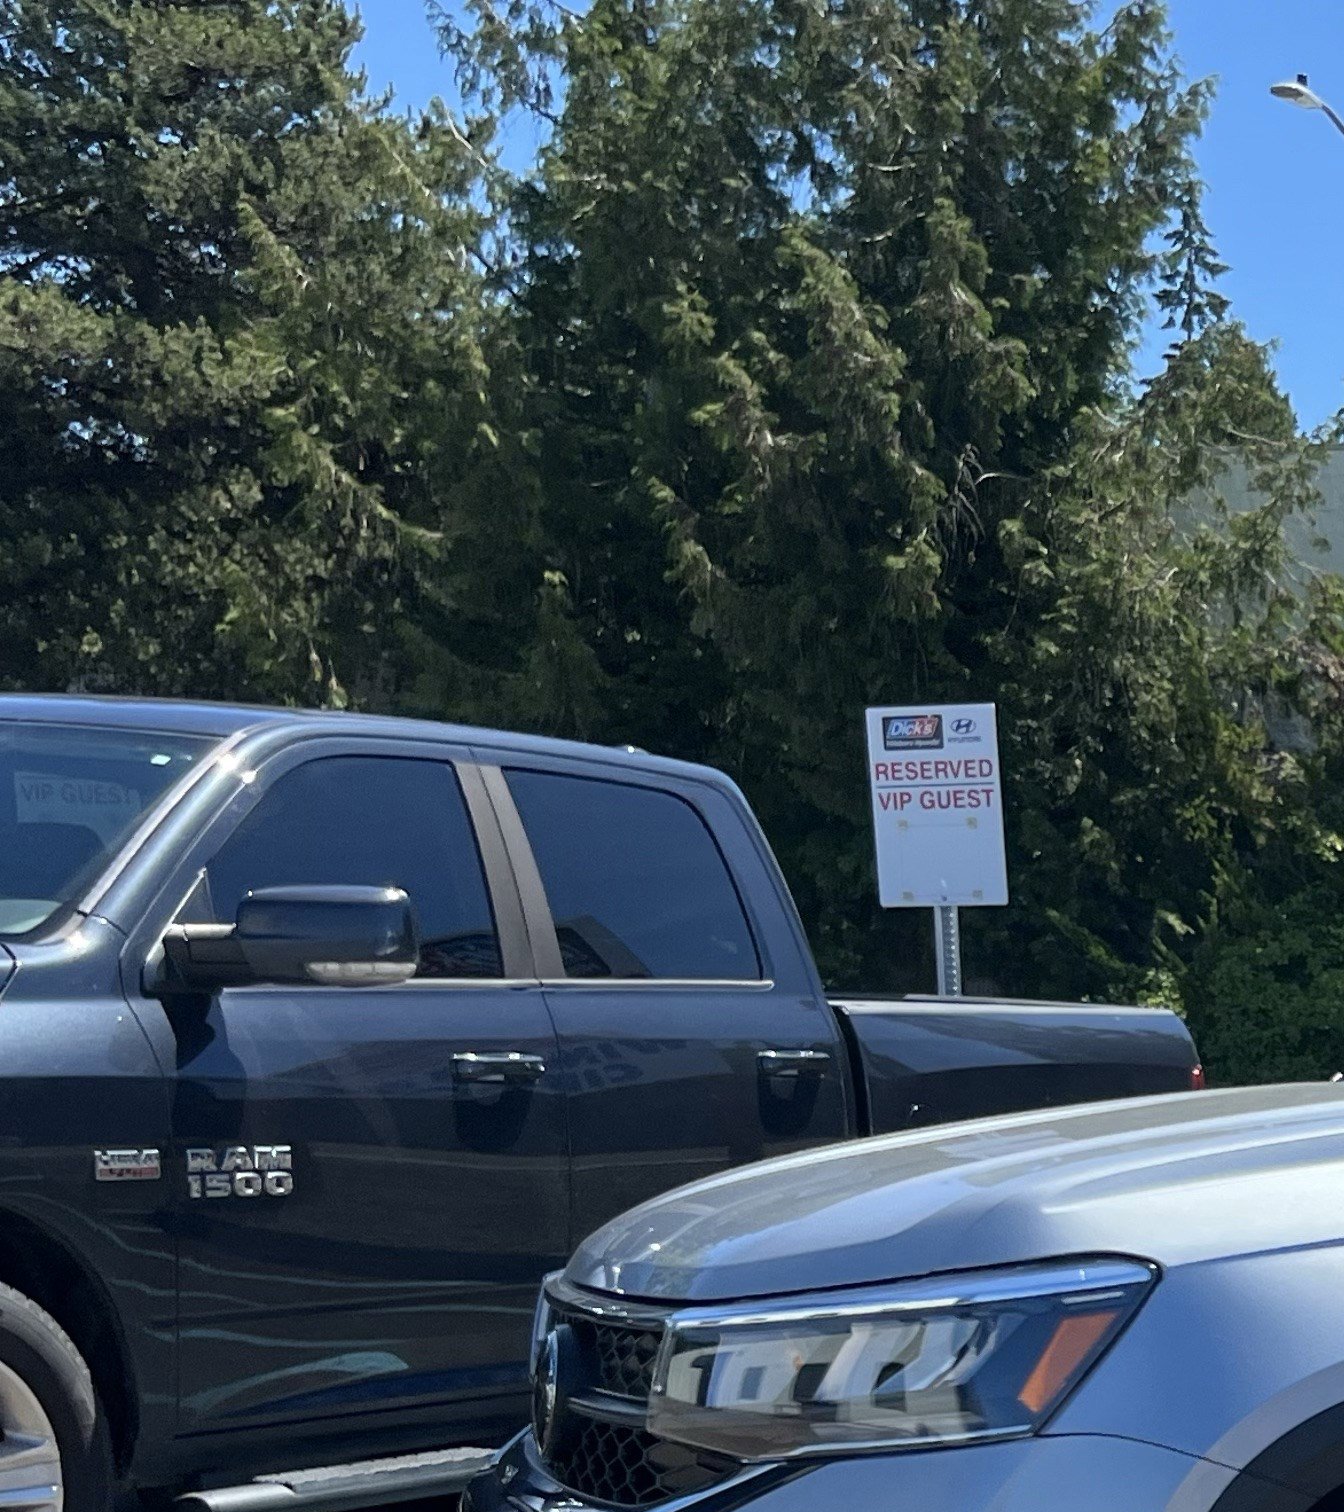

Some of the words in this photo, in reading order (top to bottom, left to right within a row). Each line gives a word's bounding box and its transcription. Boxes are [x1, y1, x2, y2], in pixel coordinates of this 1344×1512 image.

[875, 759, 994, 781] RESERVED
[878, 791, 913, 811] VIP
[919, 789, 995, 810] GUEST
[186, 1145, 293, 1173] RAM
[187, 1171, 294, 1199] 1500
